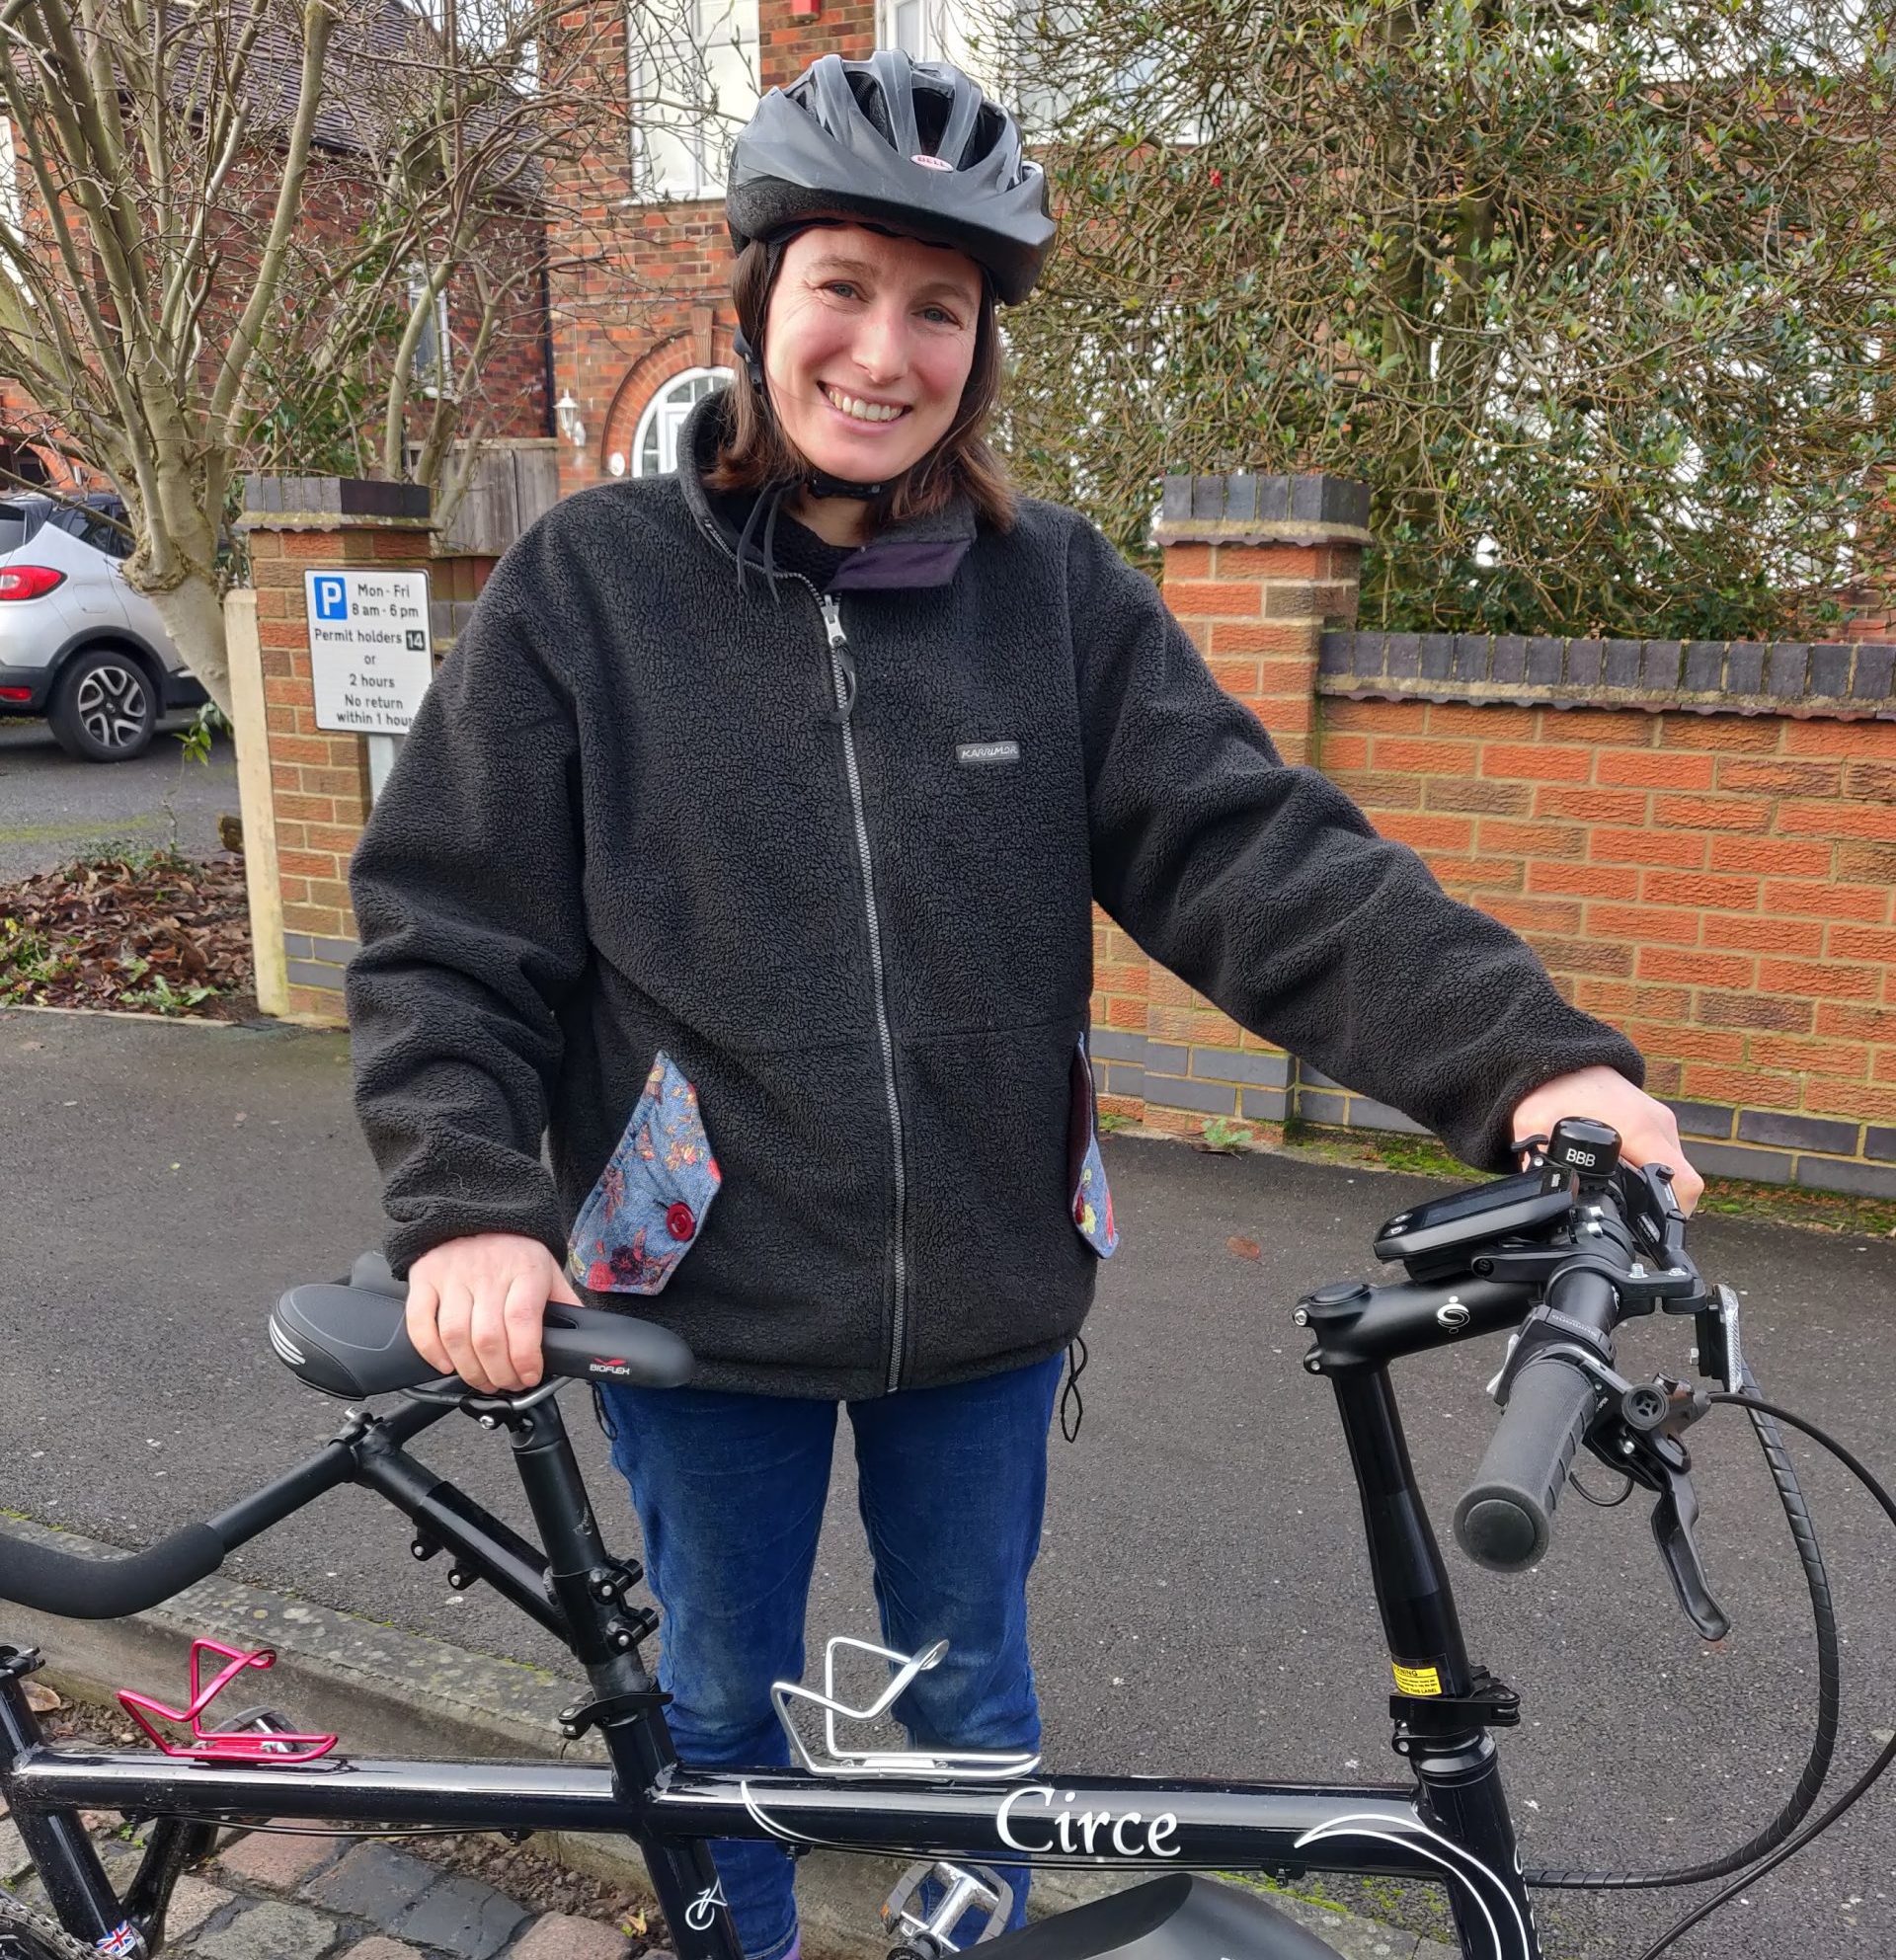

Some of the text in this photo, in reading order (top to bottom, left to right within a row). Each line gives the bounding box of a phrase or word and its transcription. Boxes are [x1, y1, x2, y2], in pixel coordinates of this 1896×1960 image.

[916, 156, 947, 167] BELL
[321, 581, 343, 616] P
[357, 584, 384, 597] Mon
[394, 585, 410, 597] Fri
[315, 628, 424, 649] Permit holders 14
[363, 655, 375, 666] or
[349, 672, 395, 688] 2 hours
[345, 693, 403, 709] No return
[337, 711, 372, 725] within
[377, 713, 382, 725] 1
[1566, 1147, 1596, 1167] BBB
[590, 1364, 630, 1374] BIOFLEX
[996, 1786, 1181, 1856] Circe
